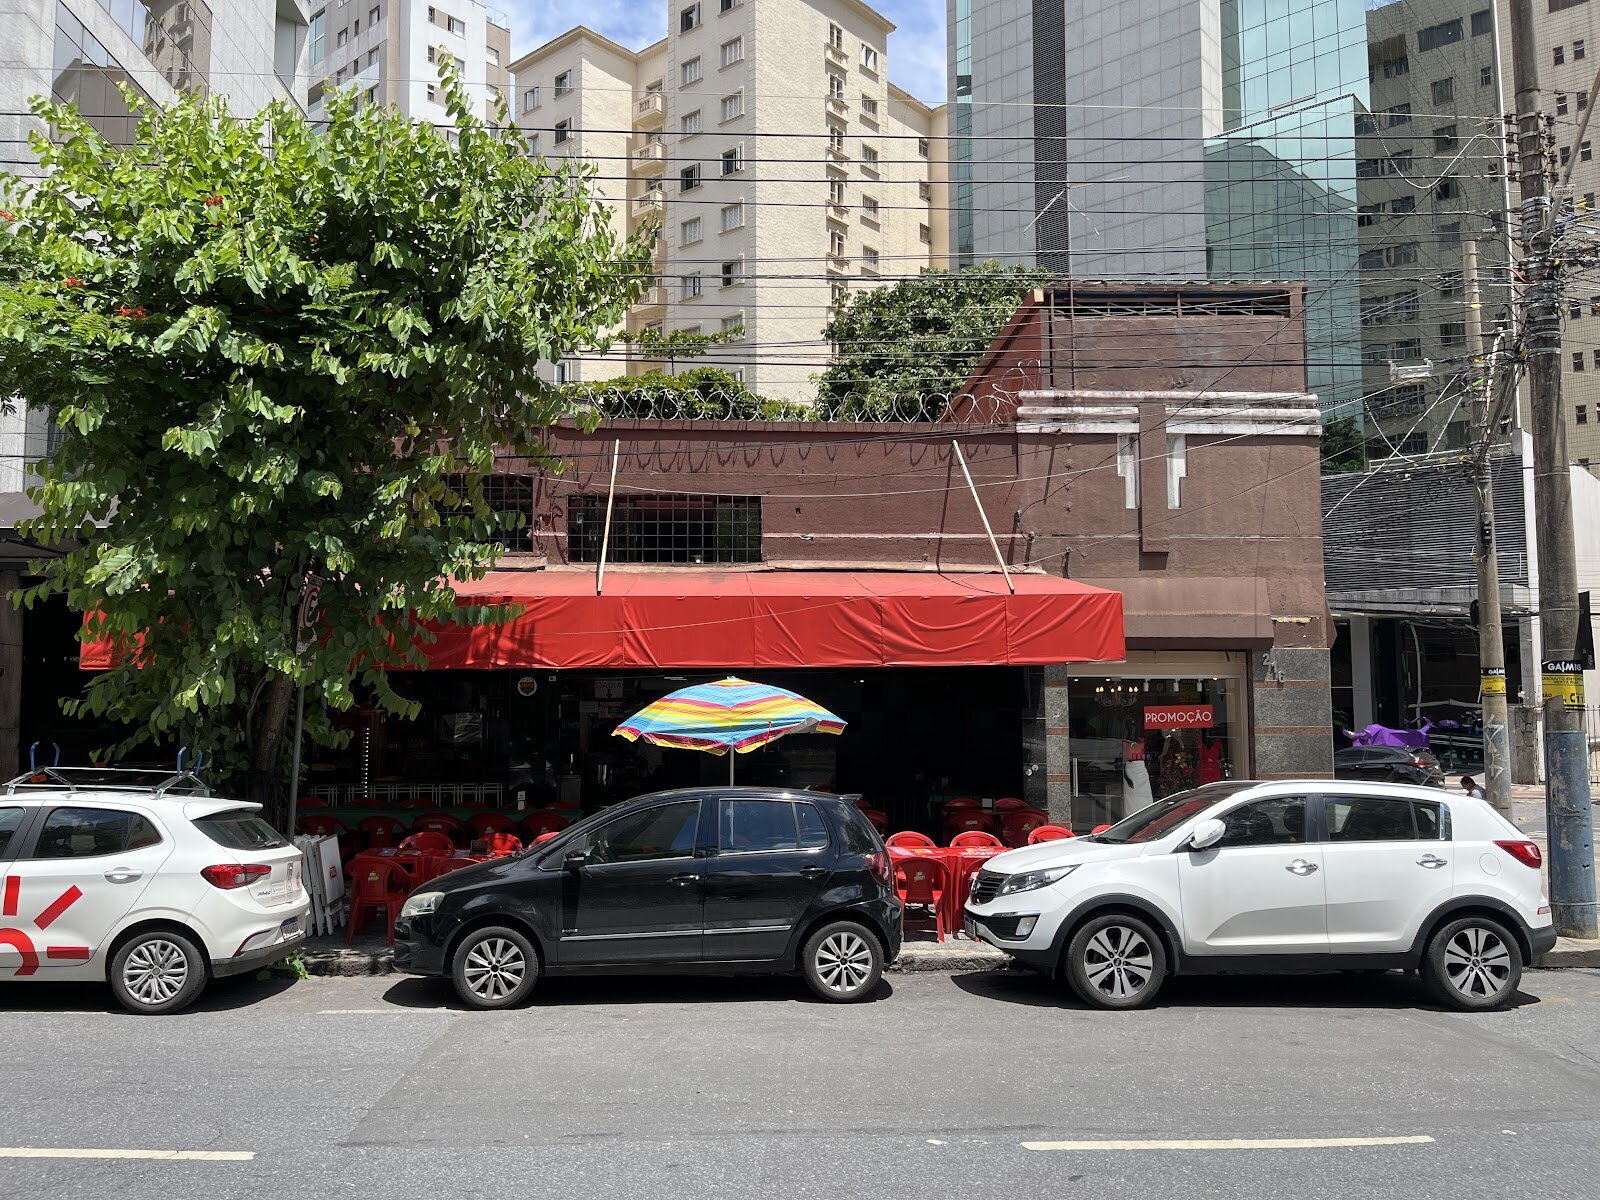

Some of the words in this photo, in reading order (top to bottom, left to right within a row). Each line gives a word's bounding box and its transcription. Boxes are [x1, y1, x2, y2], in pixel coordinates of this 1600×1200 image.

[1547, 661, 1581, 672] GASMIG
[596, 681, 622, 689] CAIXA
[1145, 710, 1211, 723] PROMOÇÃO
